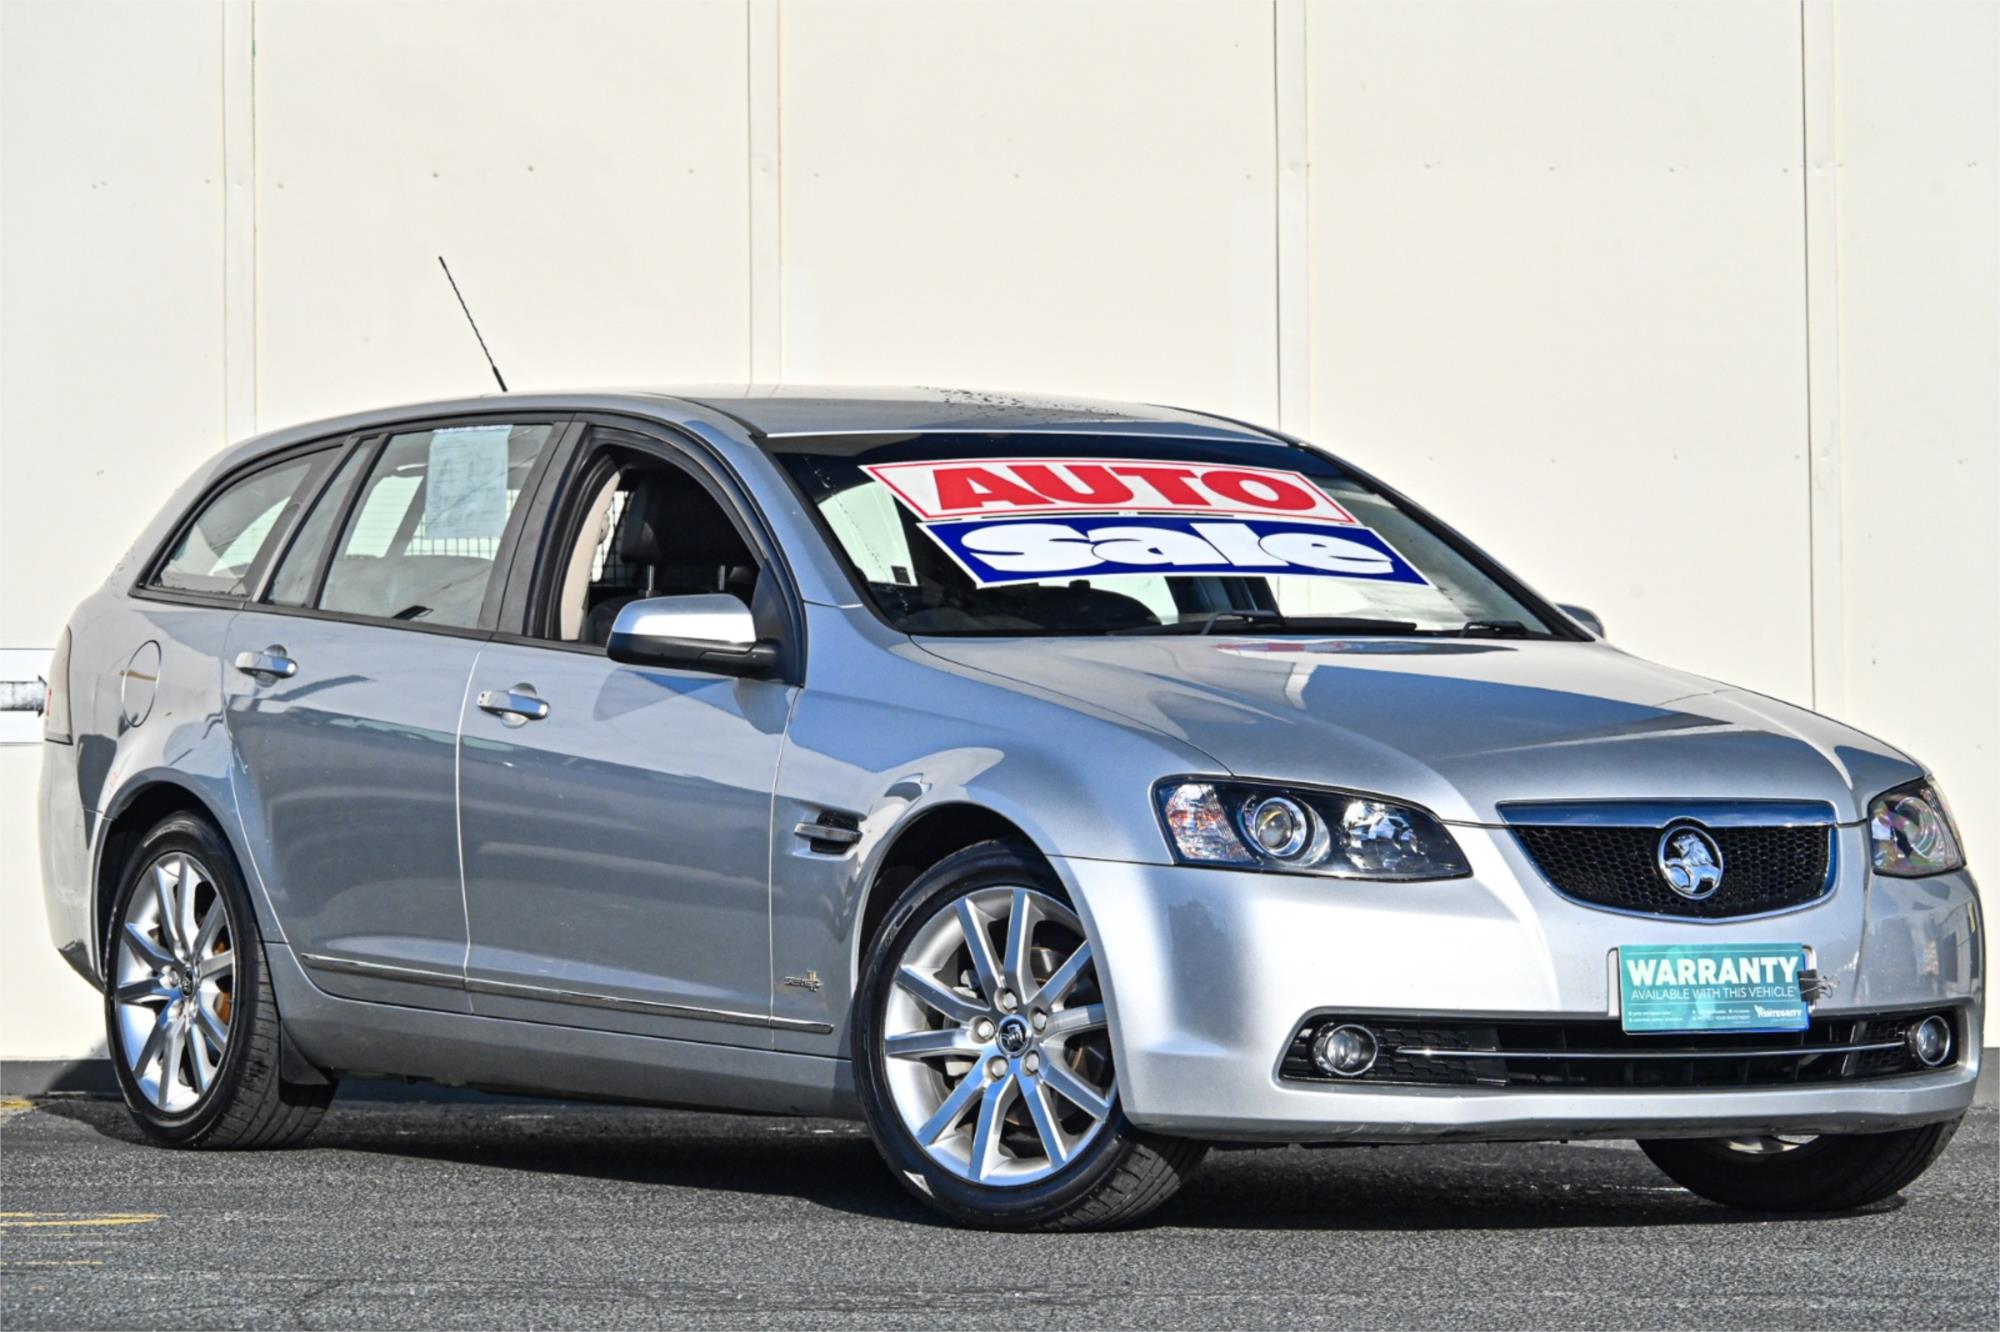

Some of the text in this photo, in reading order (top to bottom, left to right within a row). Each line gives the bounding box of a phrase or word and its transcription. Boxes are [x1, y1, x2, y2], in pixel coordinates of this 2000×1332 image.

[932, 465, 1317, 510] AUTO
[1626, 956, 1799, 986] WARRANTY
[1631, 988, 1690, 1000] AVAILABLE
[1692, 987, 1720, 999] WITH
[1723, 987, 1746, 998] THIS
